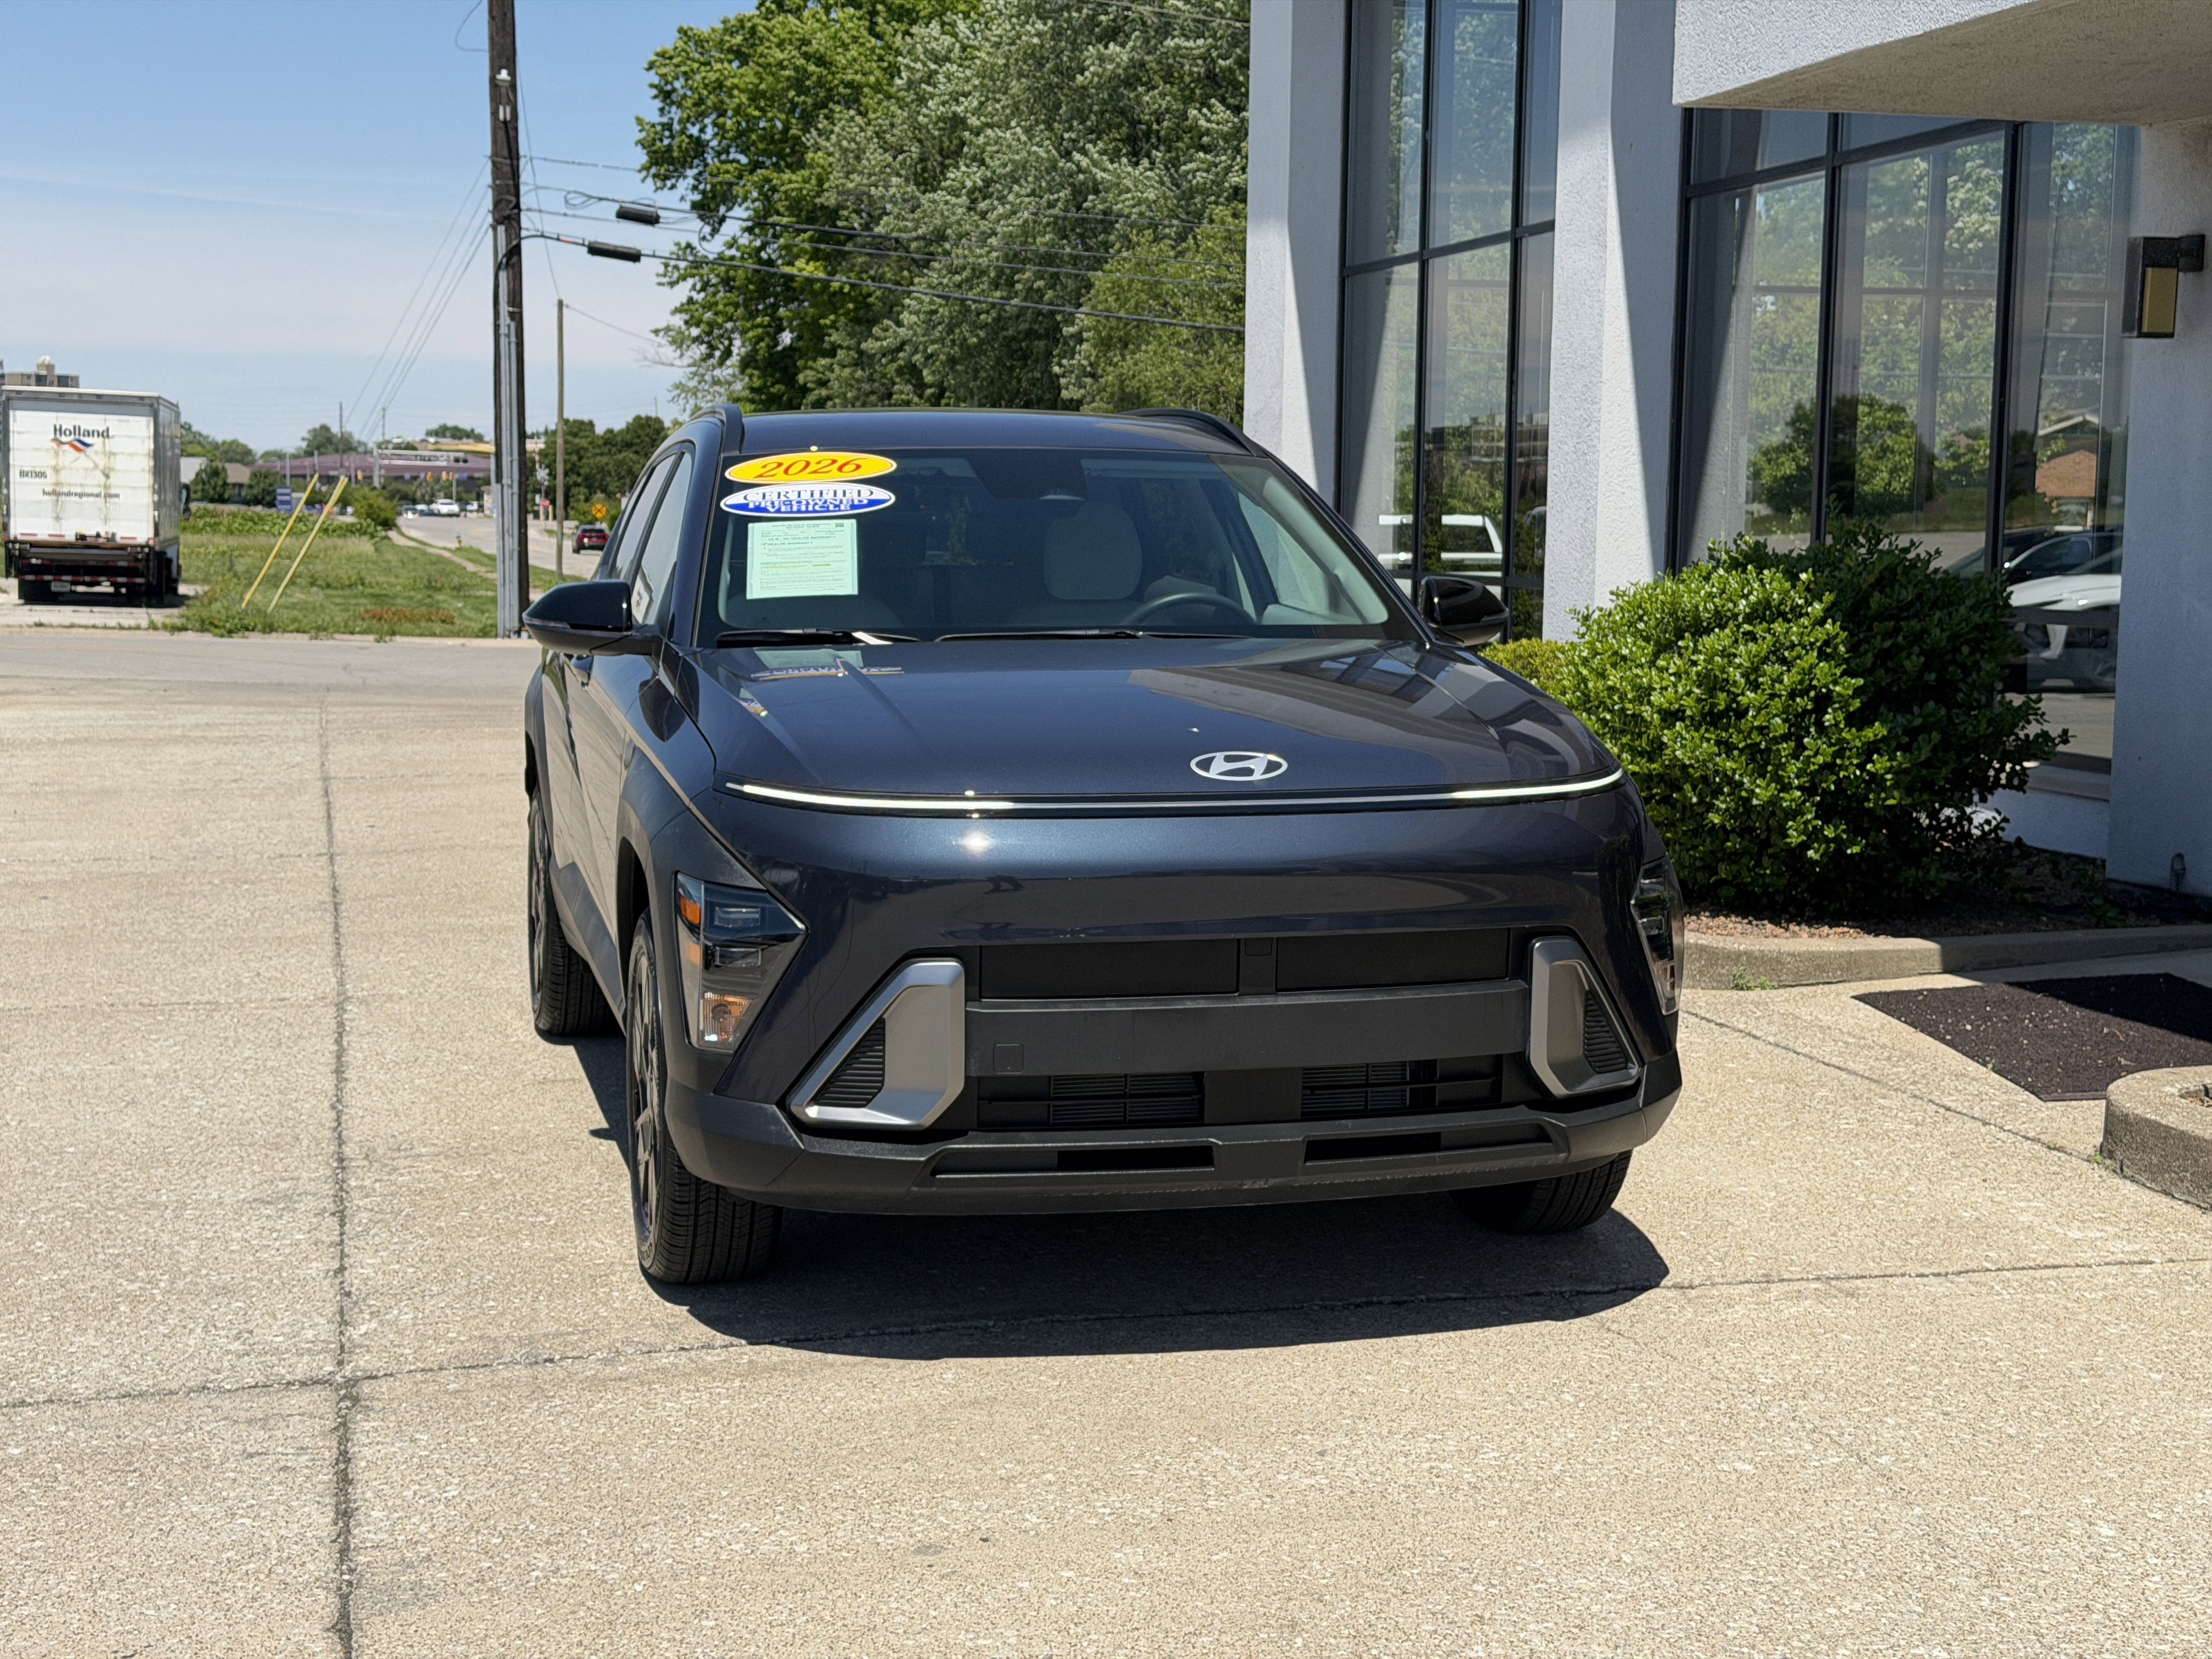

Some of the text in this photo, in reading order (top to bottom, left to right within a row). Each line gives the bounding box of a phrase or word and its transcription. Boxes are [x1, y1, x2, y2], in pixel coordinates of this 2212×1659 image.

[53, 424, 110, 438] Holland
[753, 458, 868, 479] 2026
[743, 488, 874, 502] CERTIFIED
[747, 498, 868, 509] PRE-OWNED
[768, 503, 851, 513] VEHICLE
